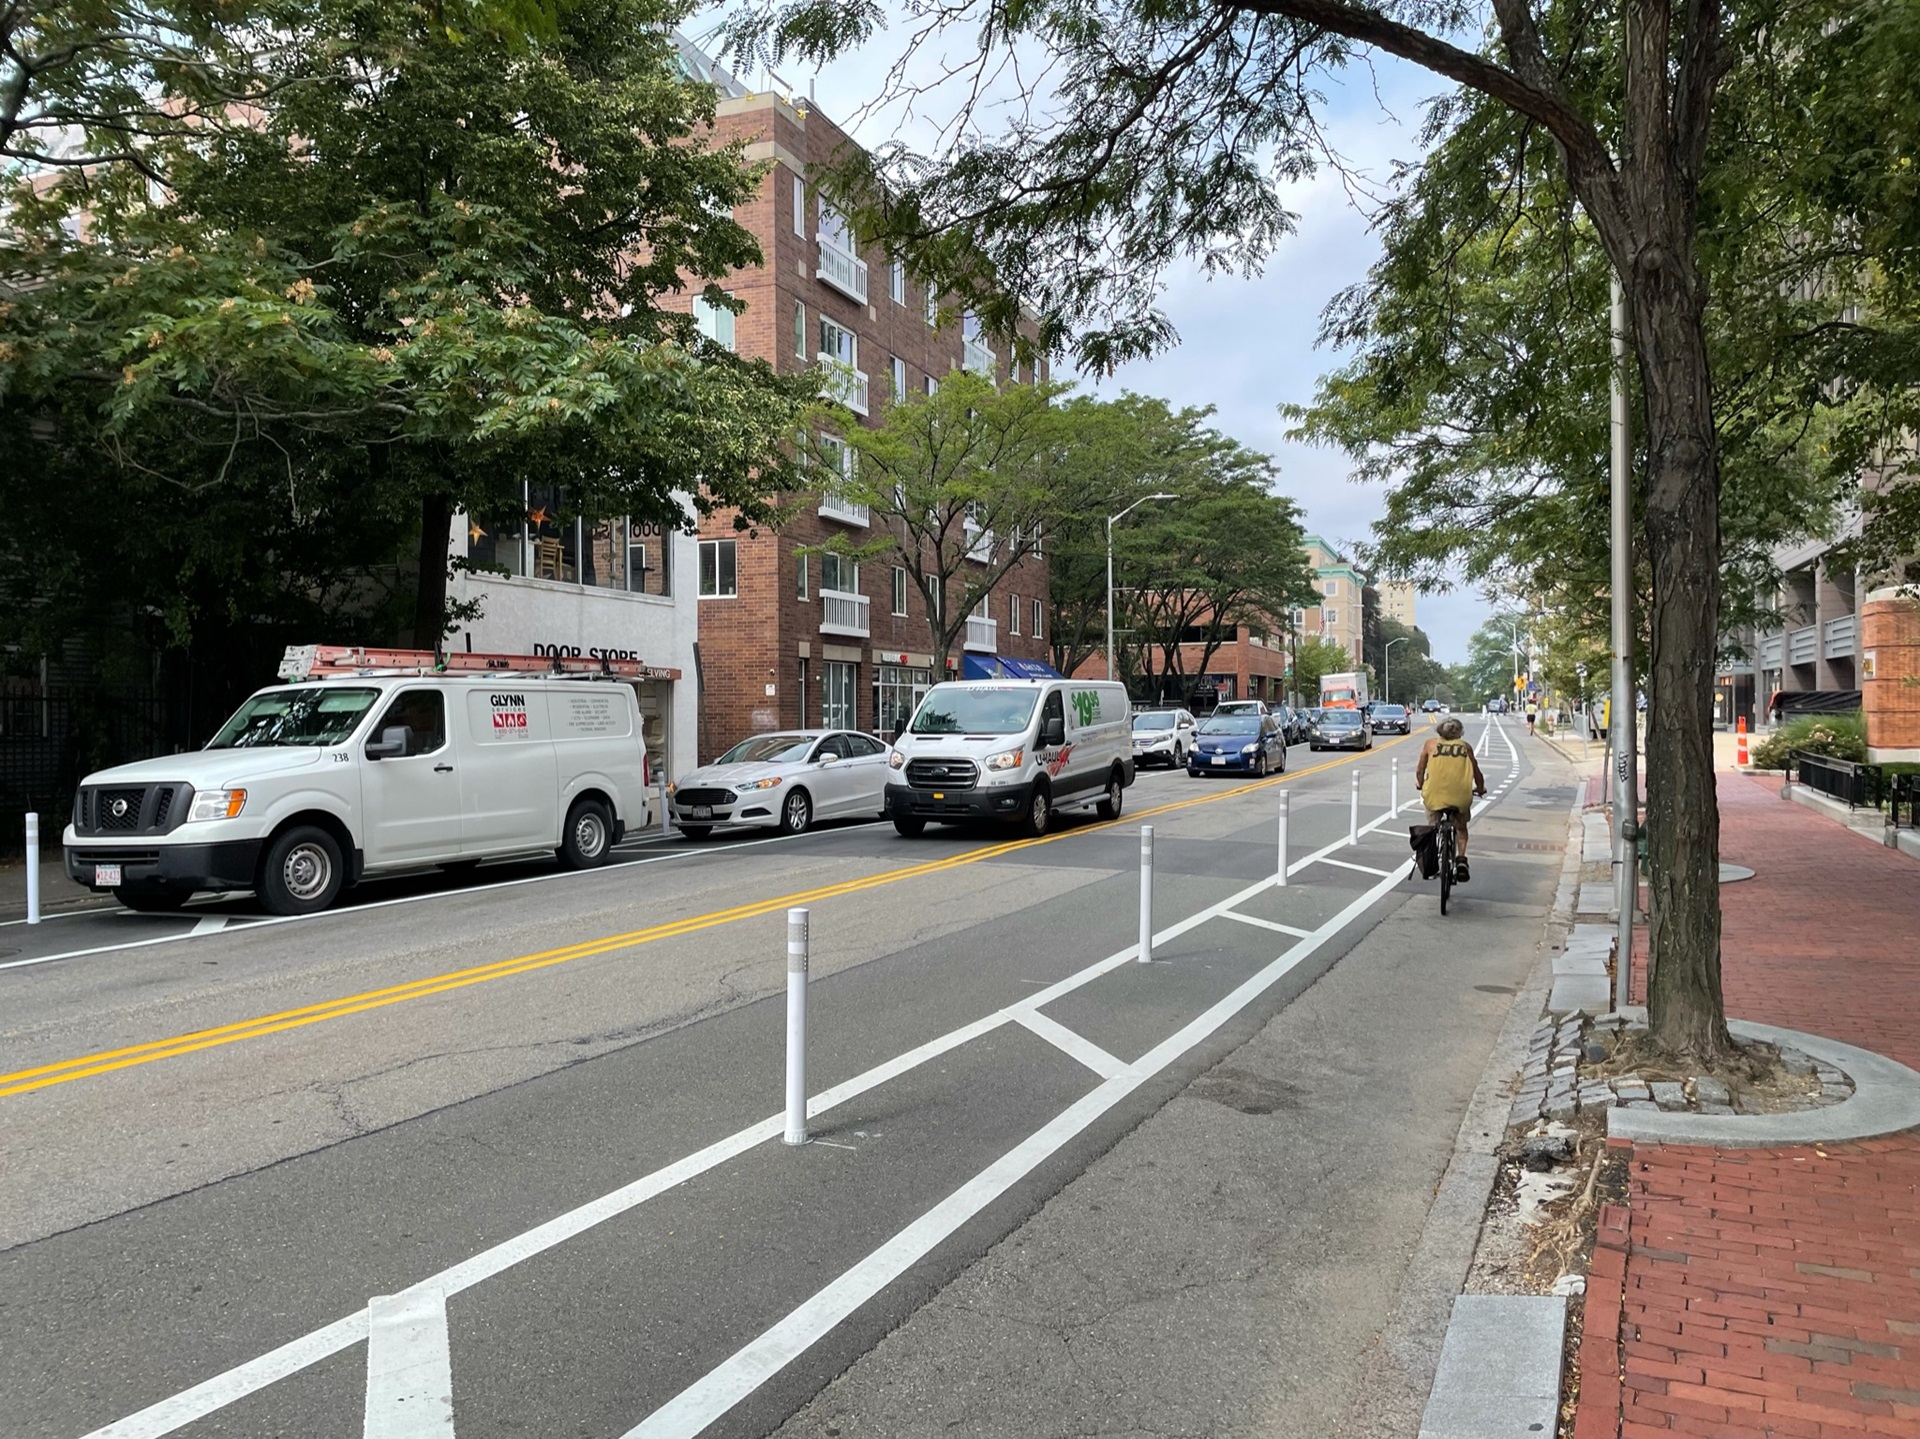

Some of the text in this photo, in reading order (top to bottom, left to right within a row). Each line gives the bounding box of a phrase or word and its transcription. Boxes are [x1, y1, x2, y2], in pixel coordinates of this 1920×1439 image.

[534, 643, 638, 661] DOOR STORE
[490, 694, 525, 707] GLYNN
[332, 753, 349, 762] 238
